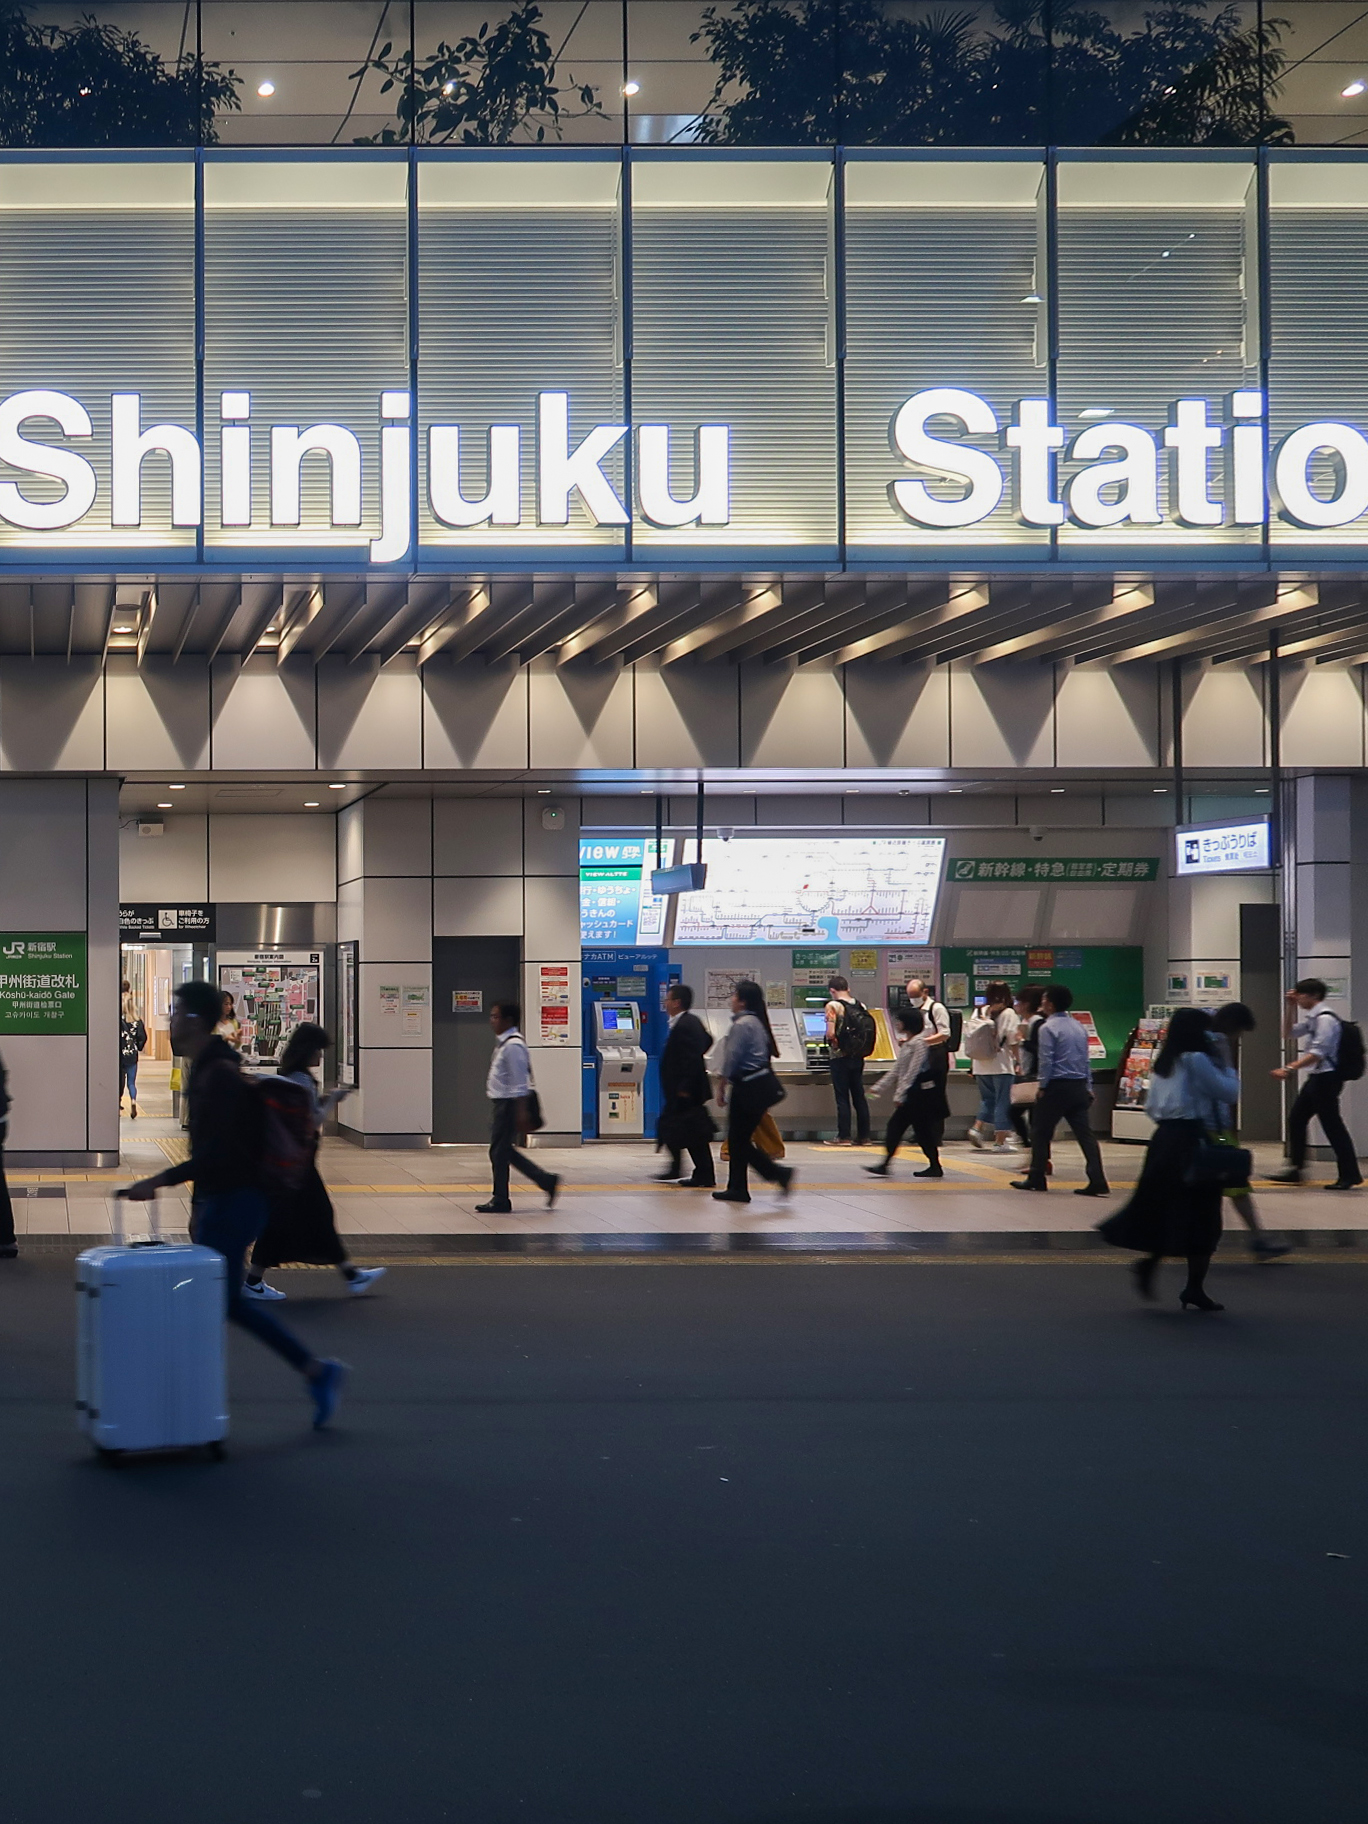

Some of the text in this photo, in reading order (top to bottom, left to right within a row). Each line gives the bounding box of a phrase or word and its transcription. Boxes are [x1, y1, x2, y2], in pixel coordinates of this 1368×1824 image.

[888, 387, 1368, 530] Statio
[1203, 831, 1258, 852] きっぷうりば
[178, 917, 210, 925] ご利用の方
[2, 942, 25, 954] JR
[27, 942, 57, 952] 新宿駅
[54, 991, 75, 999] Gate
